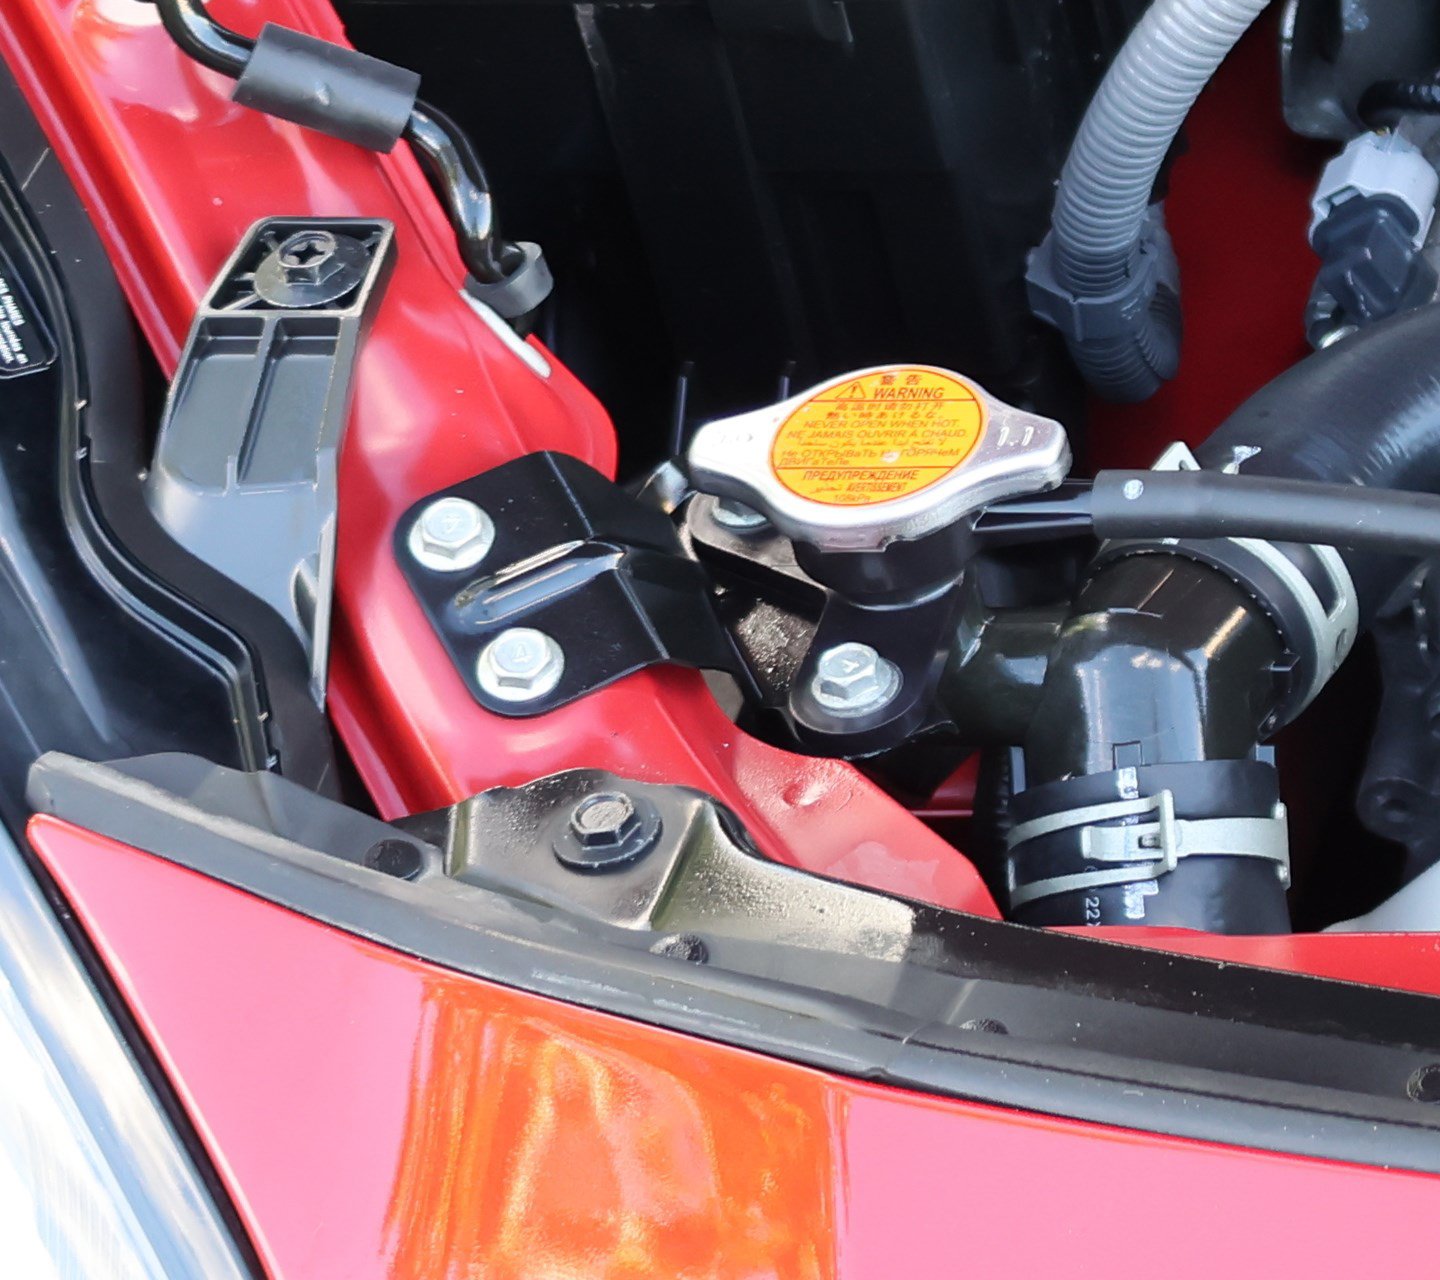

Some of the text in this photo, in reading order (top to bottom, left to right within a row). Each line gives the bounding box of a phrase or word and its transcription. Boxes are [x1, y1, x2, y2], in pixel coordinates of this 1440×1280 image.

[873, 387, 945, 399] WARNING
[803, 419, 960, 429] NEVER OPEN WHEN HOT.
[786, 430, 806, 439] NE
[808, 430, 854, 439] JAMAIS
[857, 429, 906, 438] OUVRIR
[921, 428, 967, 438] CHAUD.
[802, 470, 920, 481] ПРЕДУПРЕЖДЕНИЕ
